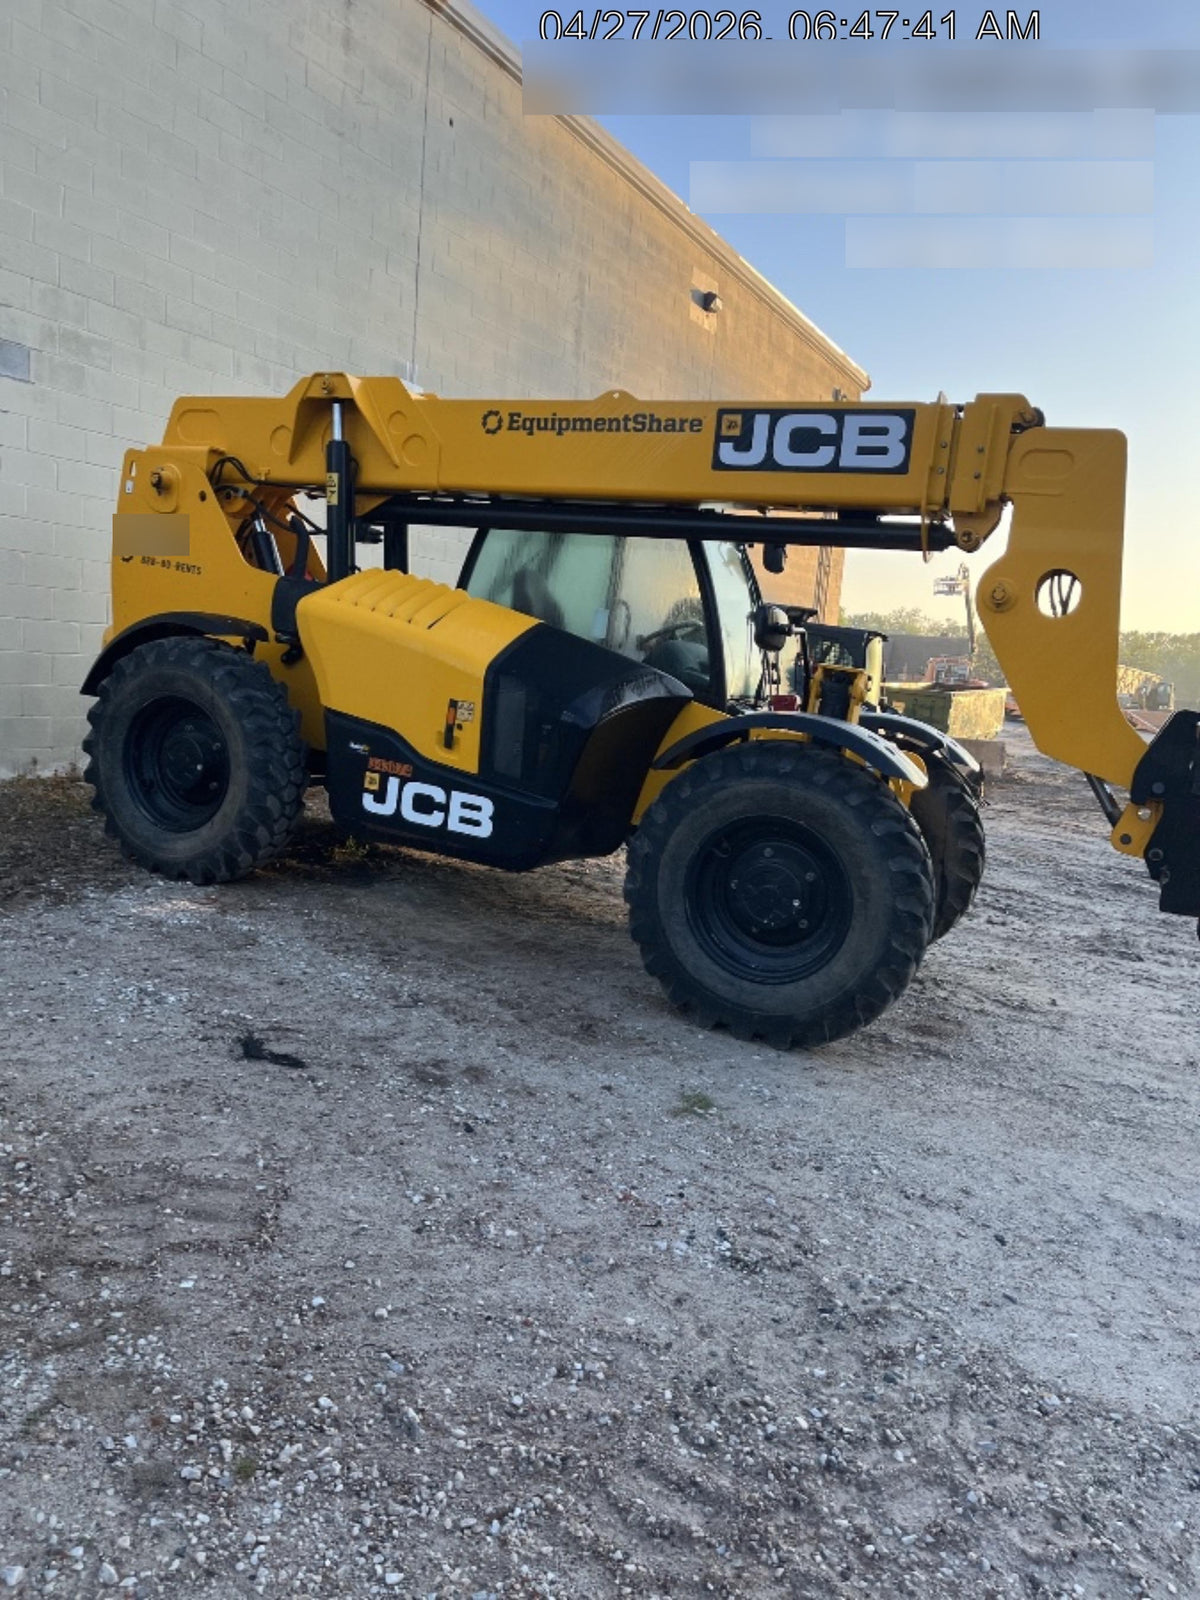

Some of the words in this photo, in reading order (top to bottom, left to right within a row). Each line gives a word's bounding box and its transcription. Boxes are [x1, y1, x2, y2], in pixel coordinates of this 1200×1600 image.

[506, 411, 704, 436] EquipmentShare
[718, 413, 907, 469] JCB
[362, 775, 495, 839] JCB
